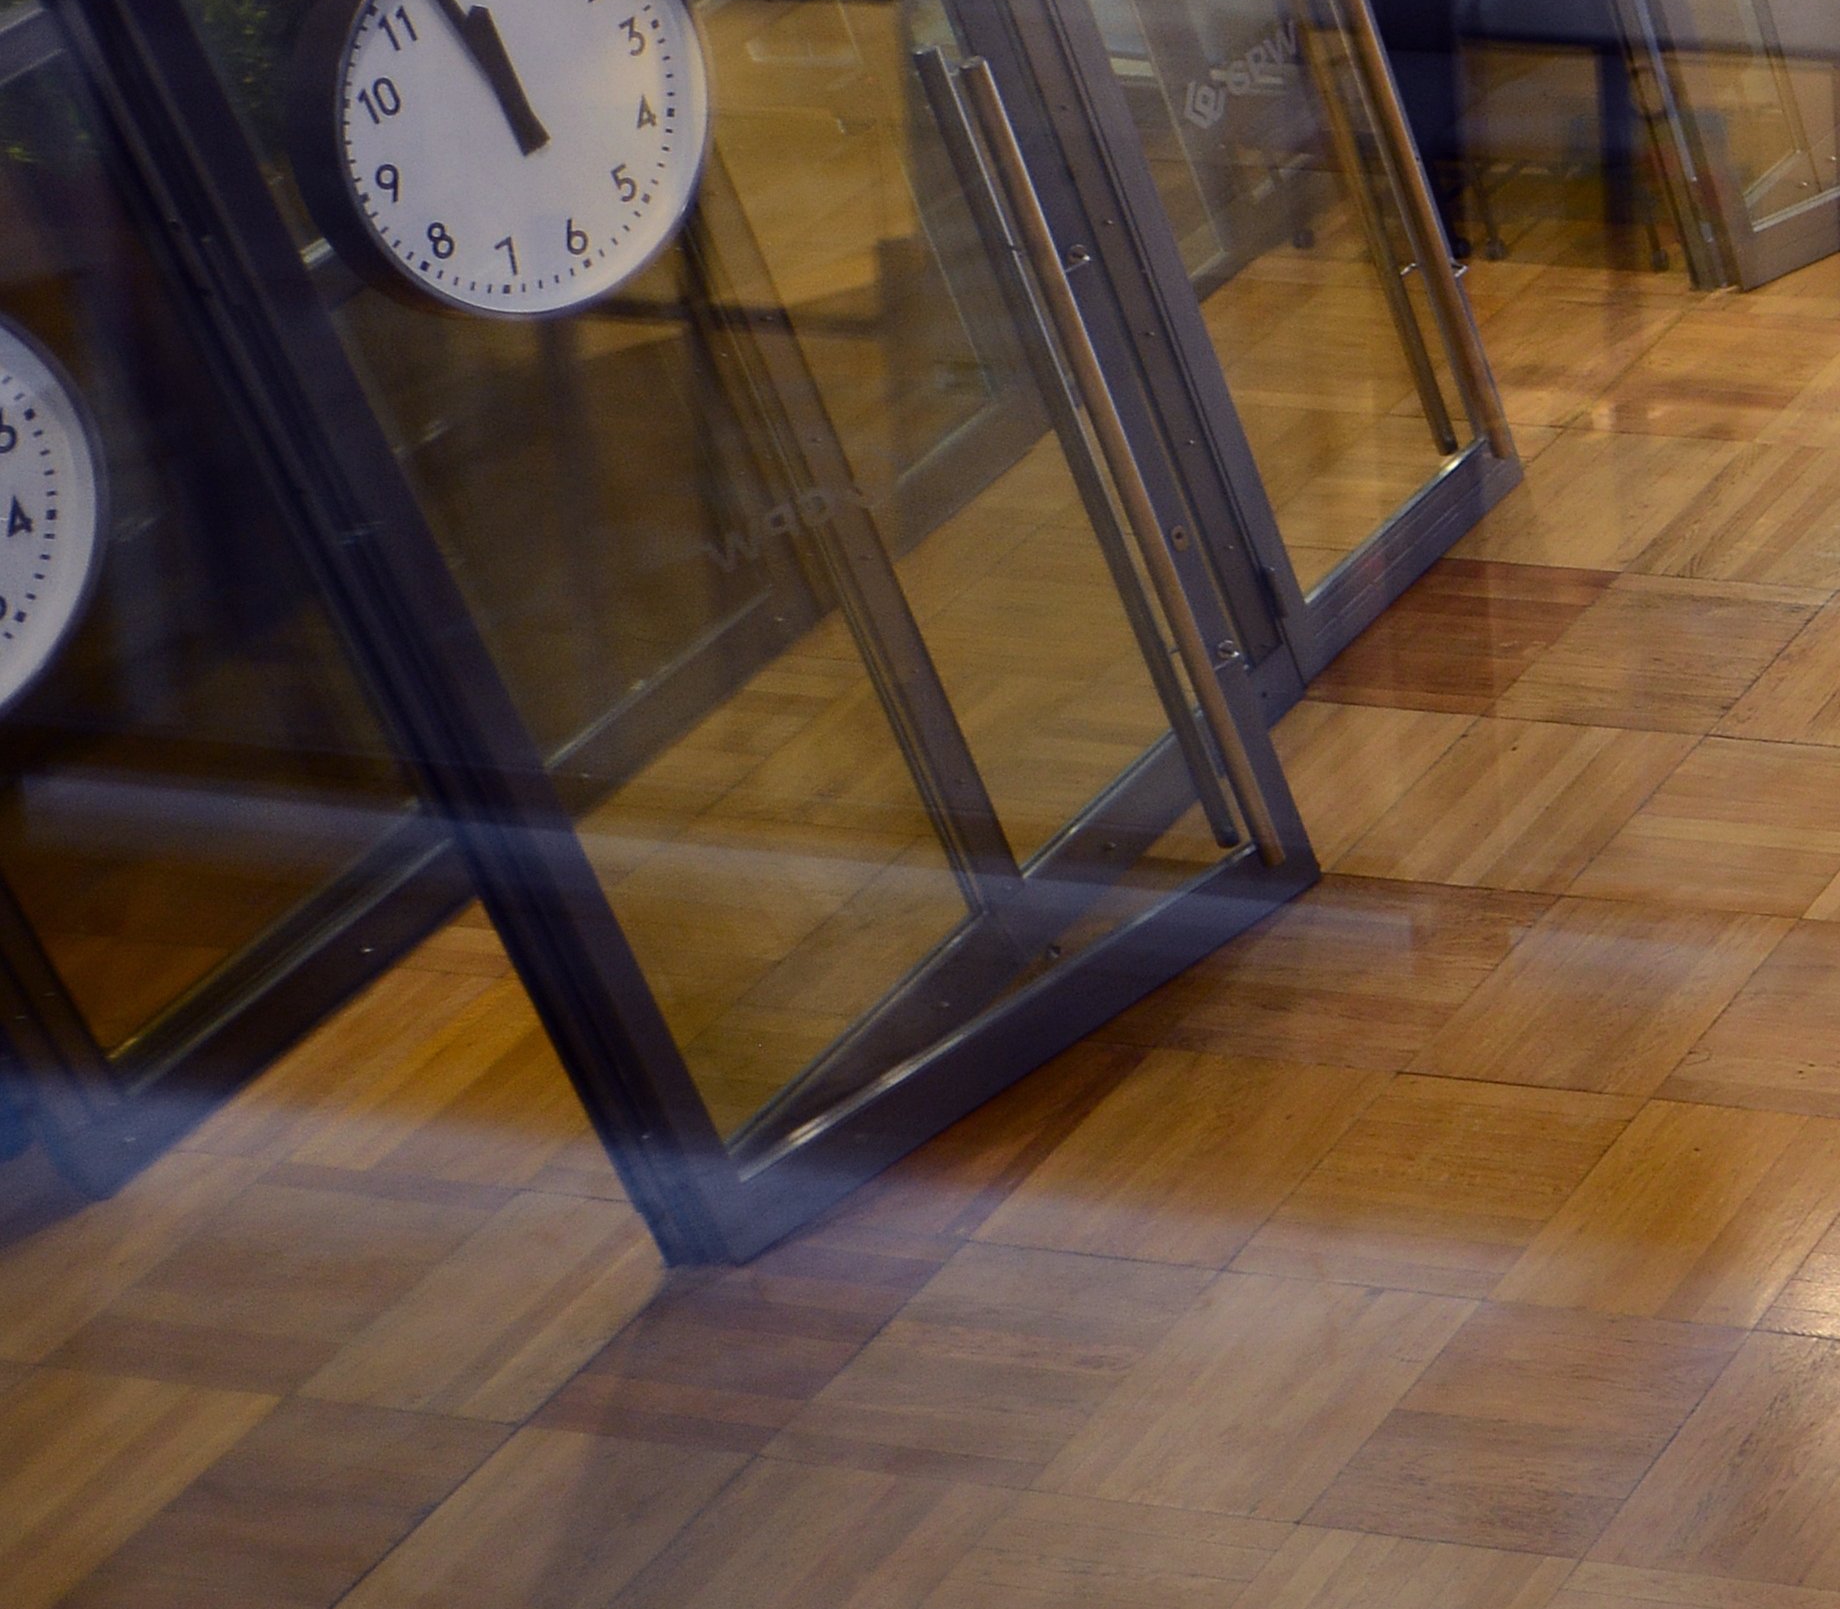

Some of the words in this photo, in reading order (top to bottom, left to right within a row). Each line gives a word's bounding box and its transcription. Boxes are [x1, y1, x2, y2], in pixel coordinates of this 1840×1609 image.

[379, 6, 418, 50] 11
[619, 16, 645, 56] 3
[358, 77, 401, 124] 10
[637, 95, 657, 130] 4
[375, 163, 400, 203] 9
[611, 163, 637, 202] 5
[427, 222, 455, 259] 8
[495, 237, 519, 275] 7
[566, 218, 589, 255] 6
